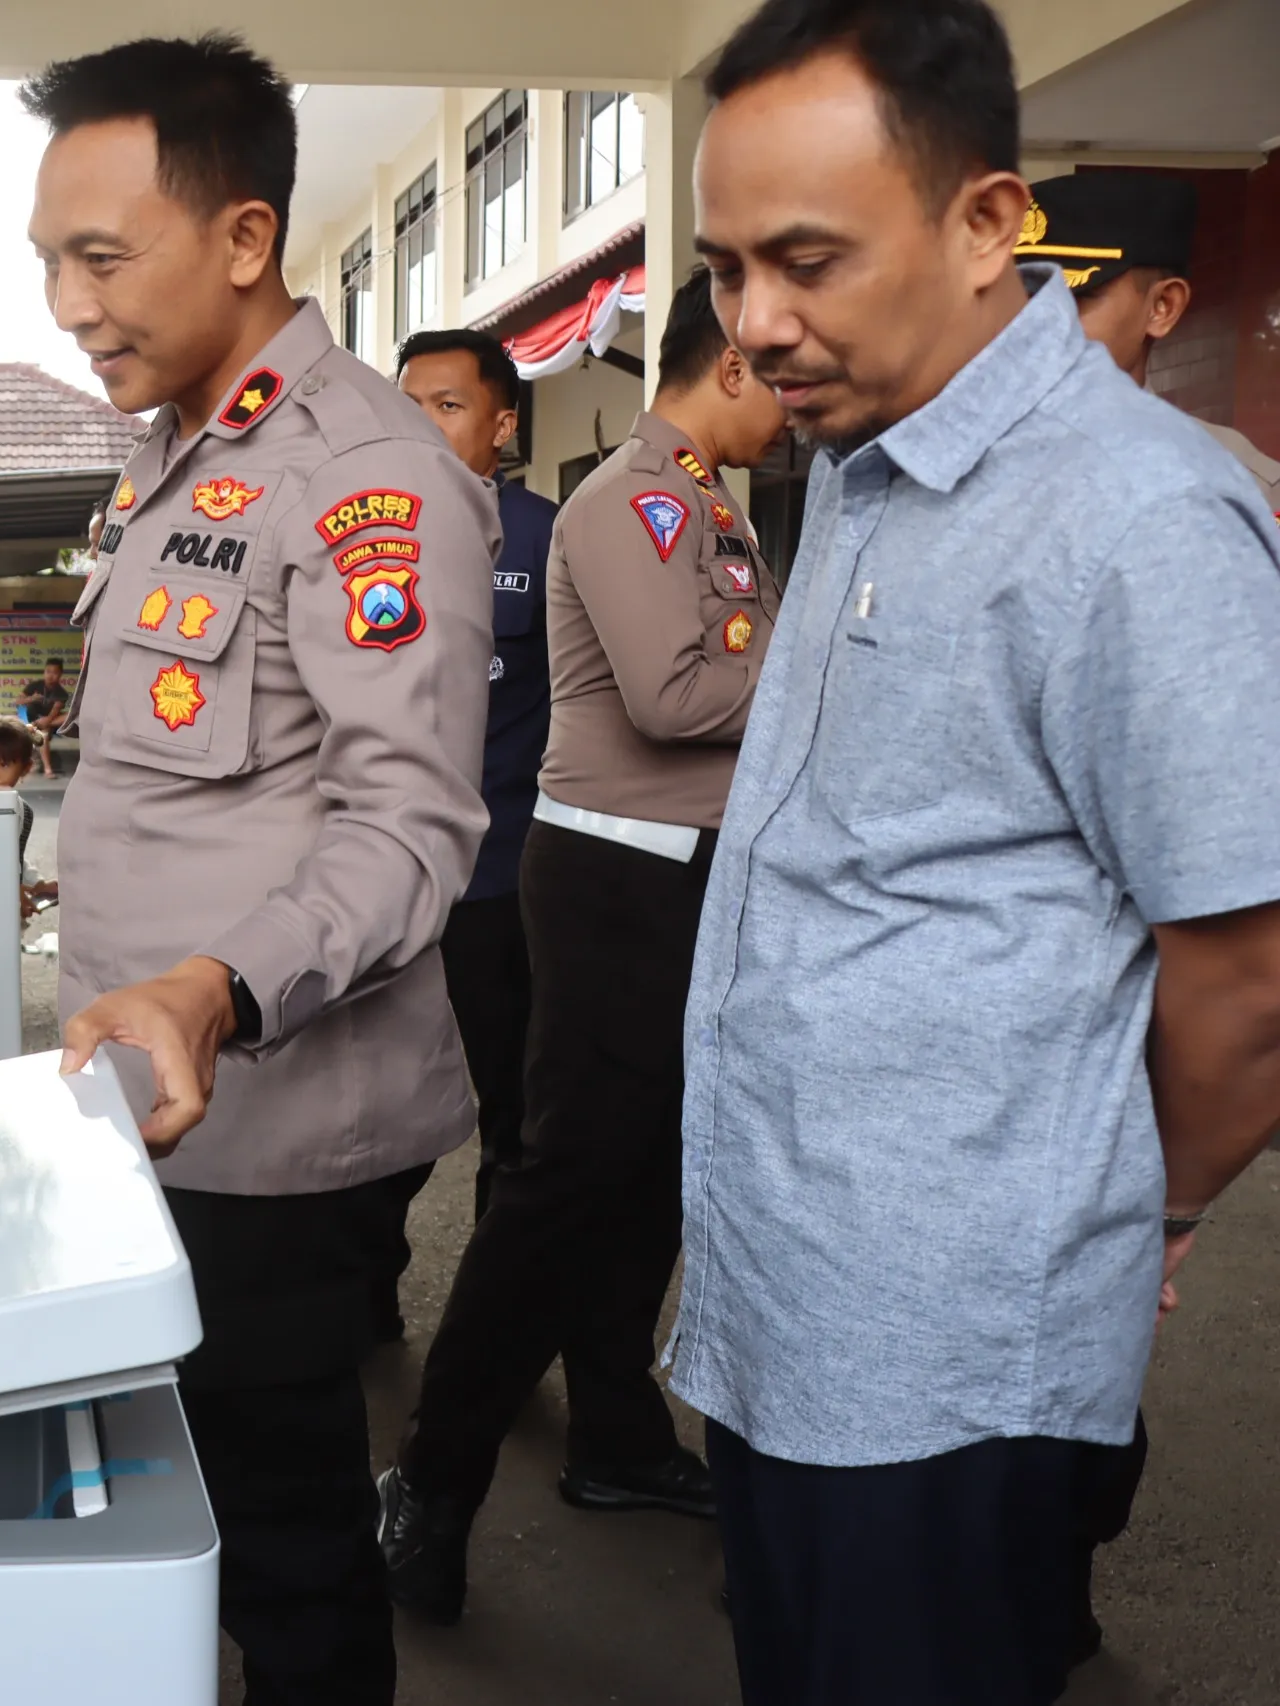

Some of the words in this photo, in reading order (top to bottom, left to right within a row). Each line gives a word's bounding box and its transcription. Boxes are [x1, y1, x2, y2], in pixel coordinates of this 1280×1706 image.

[324, 495, 412, 536] POLRES
[331, 510, 408, 537] MALANG
[160, 532, 247, 574] POLRI
[342, 545, 373, 566] JAWA
[376, 542, 414, 555] TIMUR
[2, 635, 37, 645] STNK
